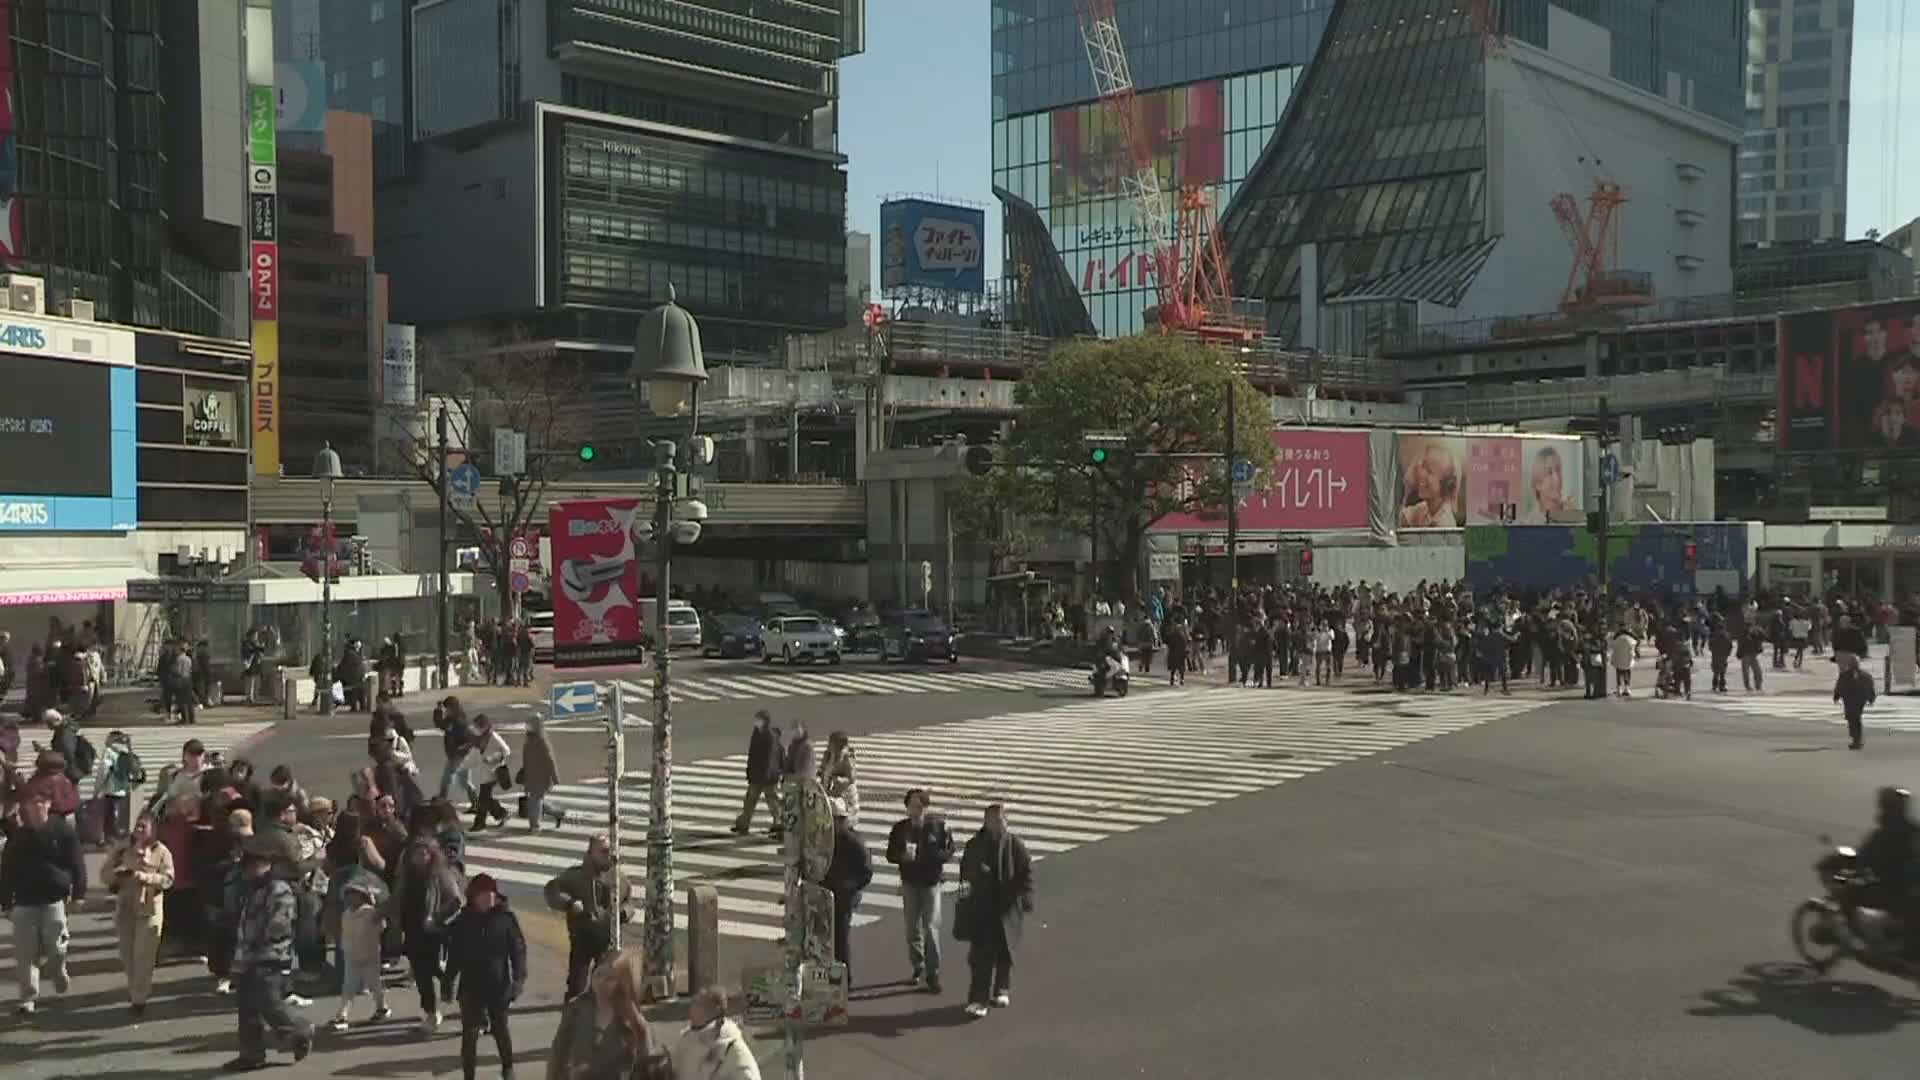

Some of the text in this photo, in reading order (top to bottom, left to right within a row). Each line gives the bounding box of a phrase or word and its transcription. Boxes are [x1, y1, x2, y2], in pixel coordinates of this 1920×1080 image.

[257, 269, 272, 309] アコム
[256, 361, 275, 432] プロミス
[193, 419, 231, 432] COFFEE
